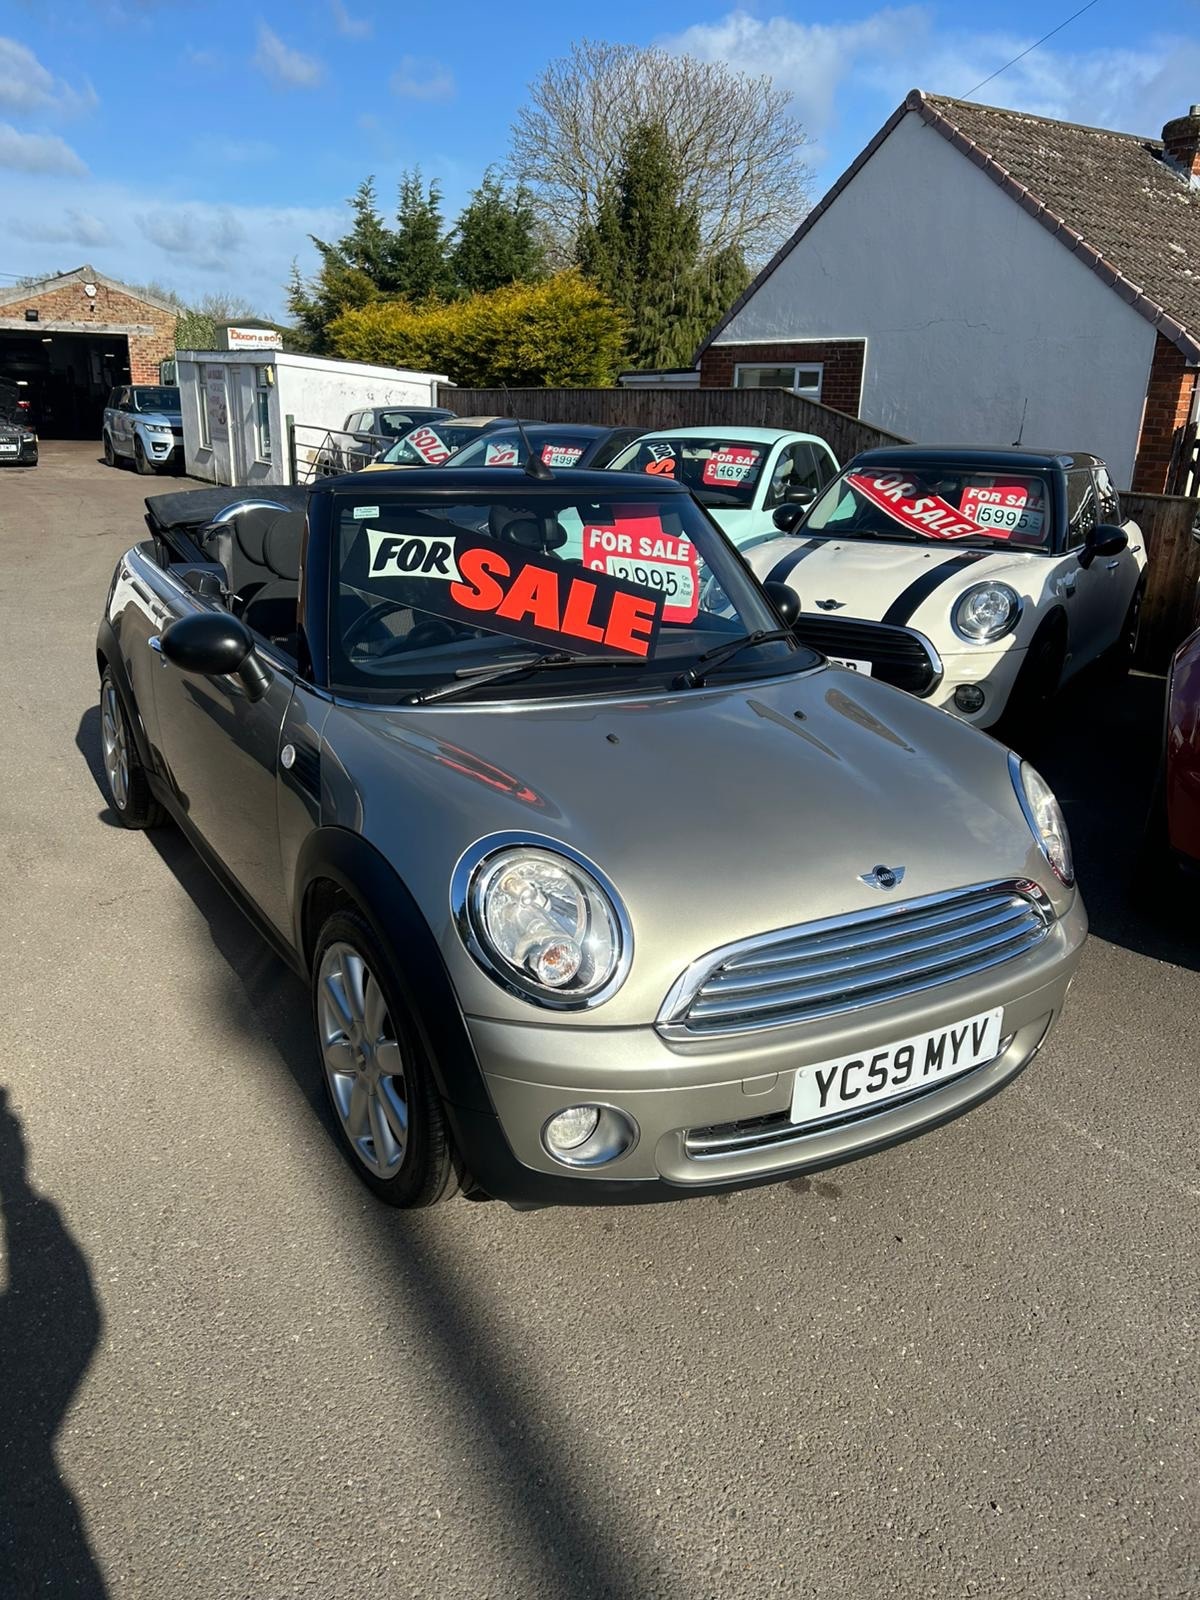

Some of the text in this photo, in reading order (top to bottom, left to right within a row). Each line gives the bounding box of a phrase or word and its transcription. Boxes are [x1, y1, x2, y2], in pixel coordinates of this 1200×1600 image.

[409, 429, 449, 463] SOLD
[547, 445, 565, 454] FOR
[710, 452, 734, 463] FOR
[967, 488, 1002, 504] FOR
[901, 497, 974, 536] SALE
[590, 528, 691, 562] FOR SALE
[371, 538, 657, 657] FOR SALE
[814, 1017, 990, 1108] YC59 MYV
